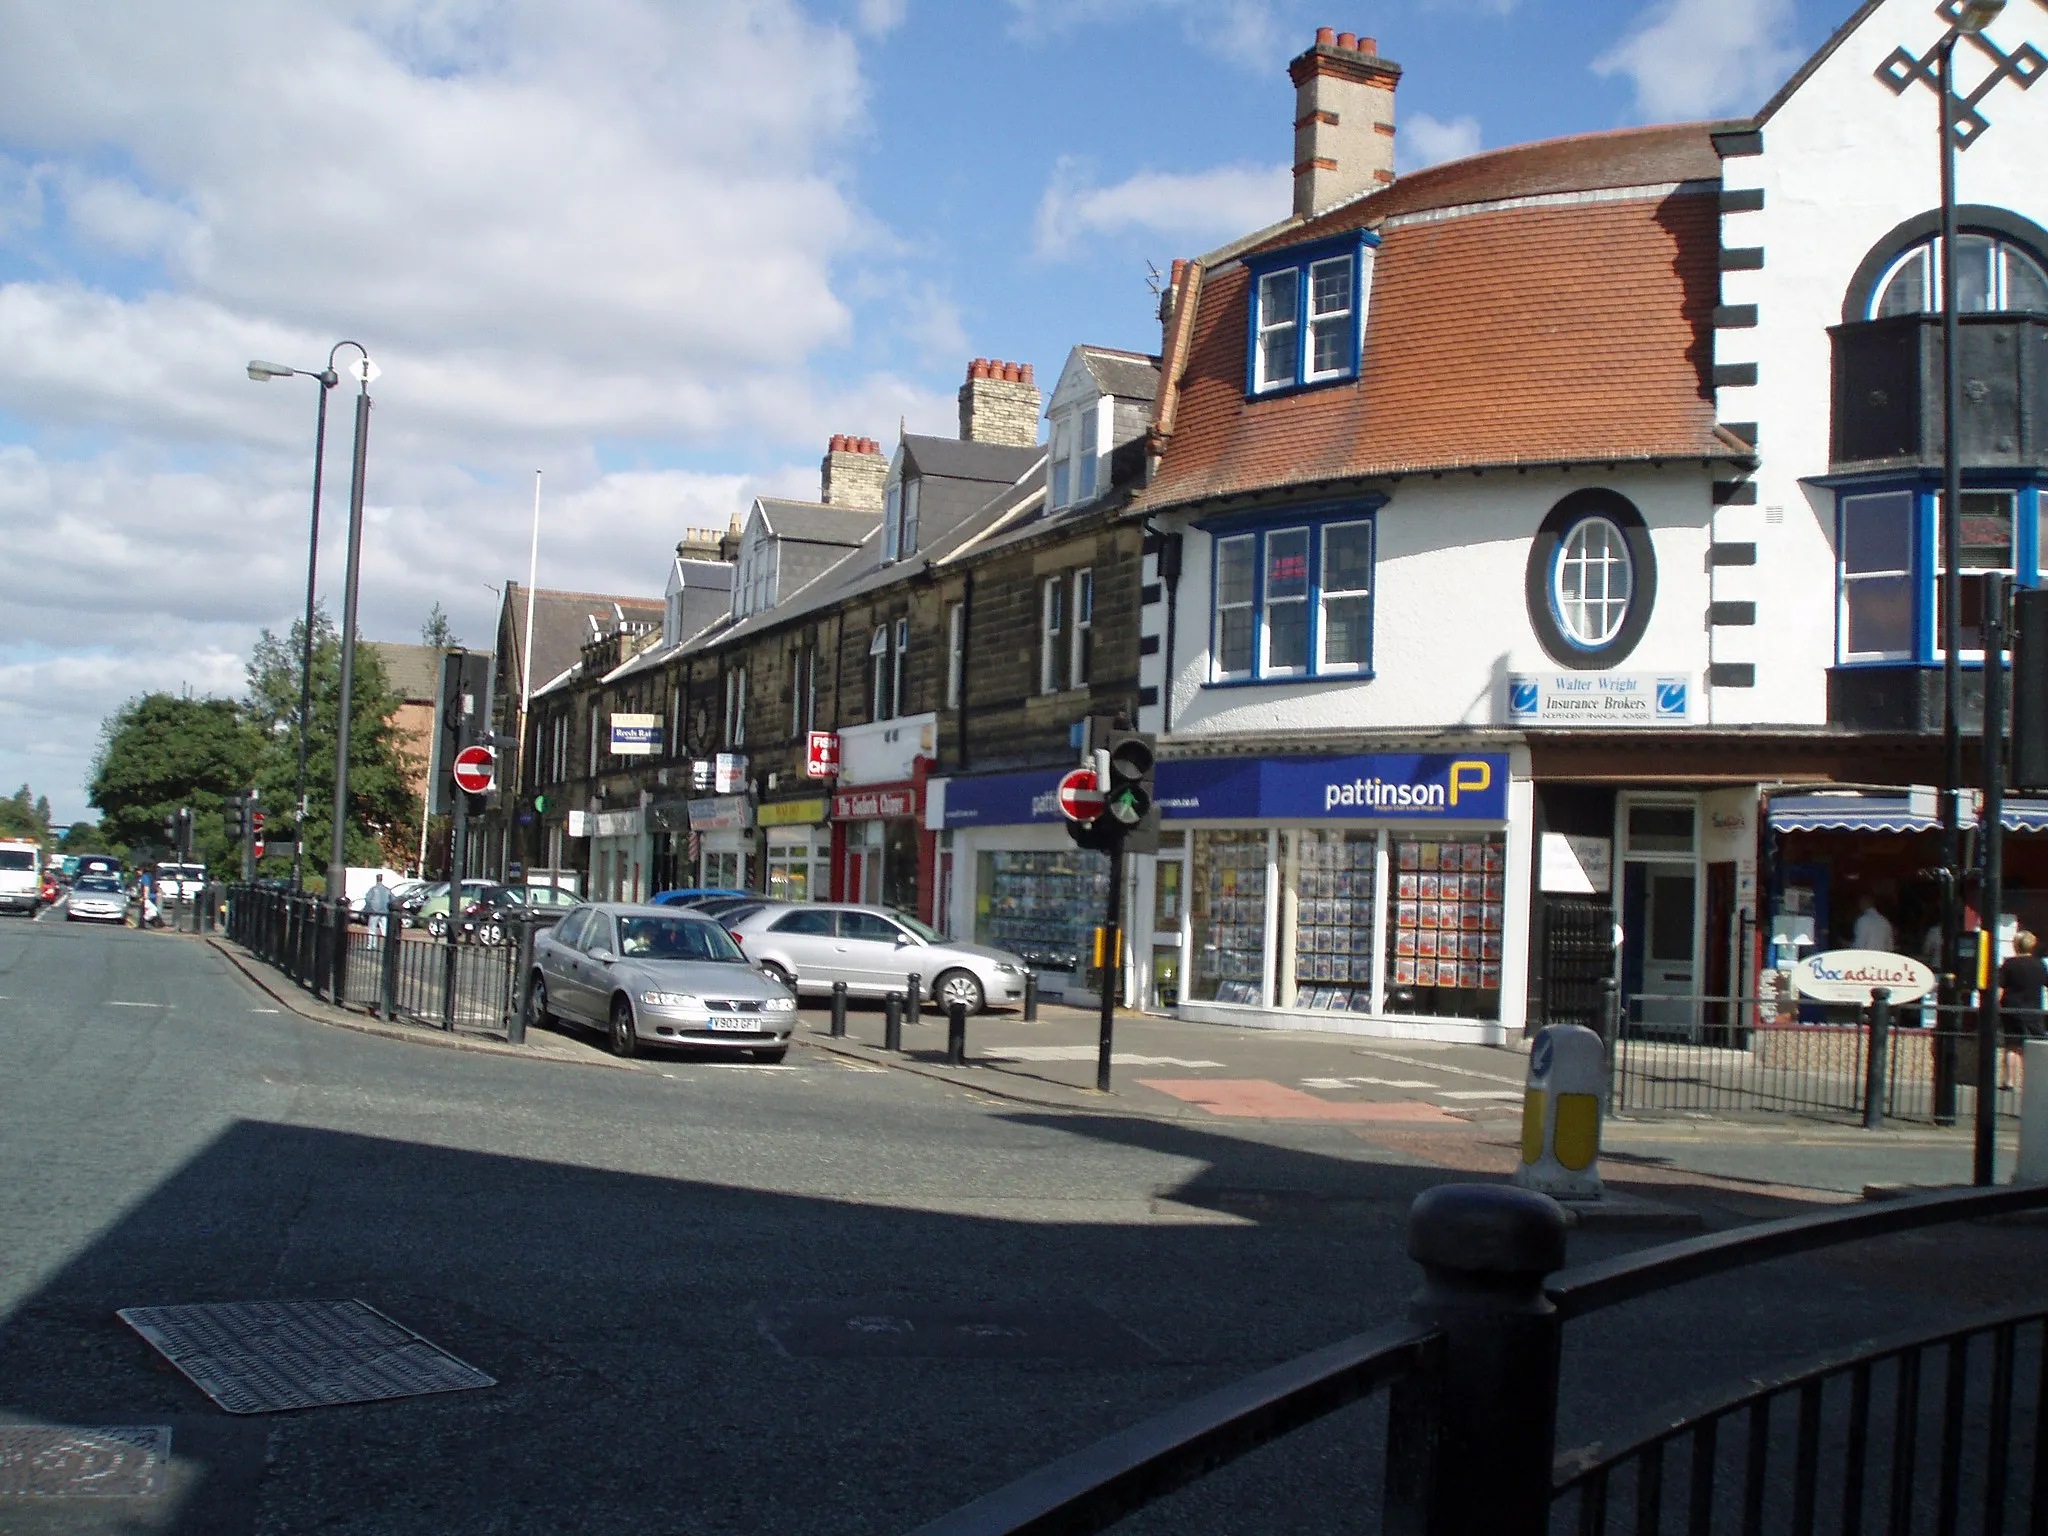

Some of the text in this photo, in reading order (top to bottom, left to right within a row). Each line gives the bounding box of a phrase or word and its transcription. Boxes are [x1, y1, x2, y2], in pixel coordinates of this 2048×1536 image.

[1556, 677, 1637, 692] Walter Wright
[1546, 696, 1646, 709] Insurance Brokers
[813, 736, 837, 749] FISH
[820, 749, 830, 761] &
[809, 760, 838, 774] CHIPS
[1326, 777, 1445, 811] pattinson
[1808, 956, 1917, 982] Bocadillo's
